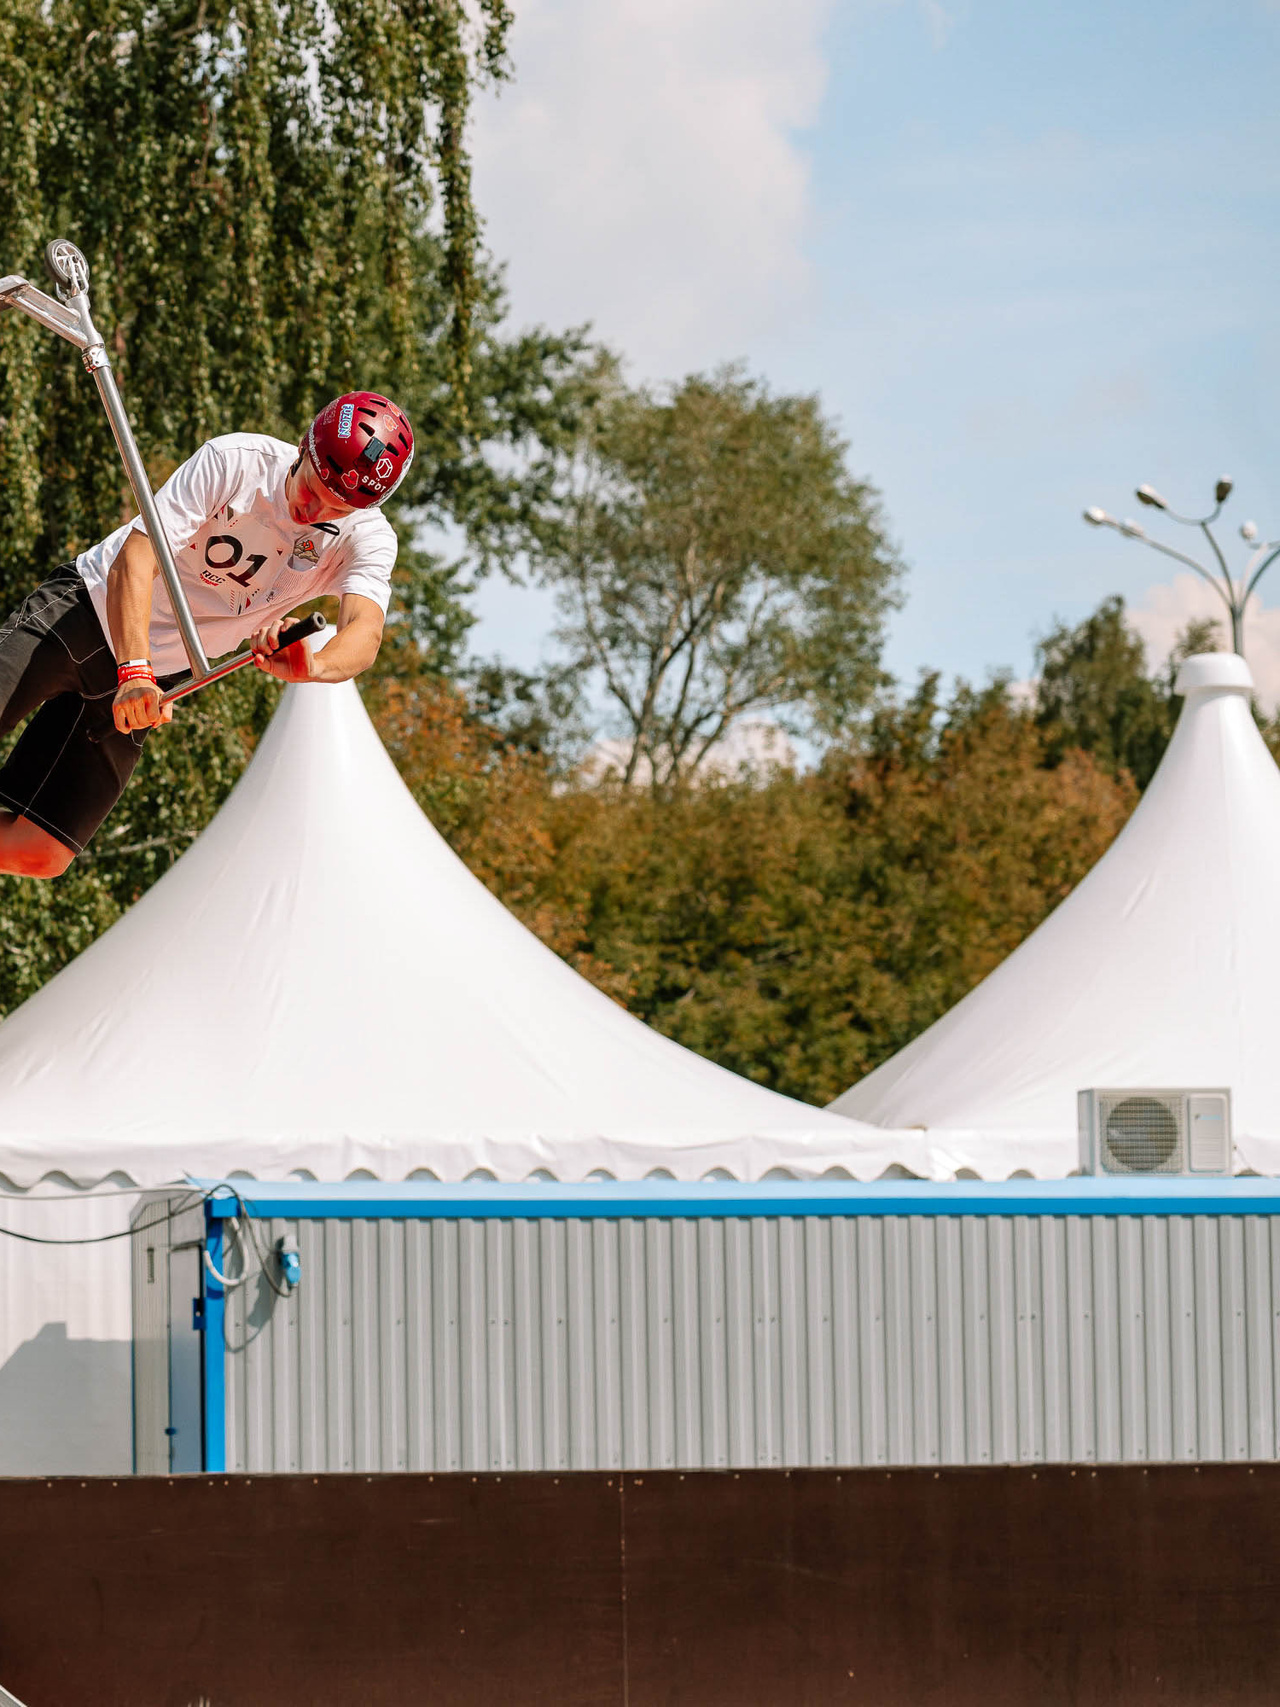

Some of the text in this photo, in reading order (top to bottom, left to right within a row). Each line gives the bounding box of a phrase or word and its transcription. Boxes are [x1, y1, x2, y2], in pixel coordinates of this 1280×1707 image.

[338, 404, 354, 438] FUZION
[202, 570, 226, 584] RCC
[205, 535, 268, 588] 01
